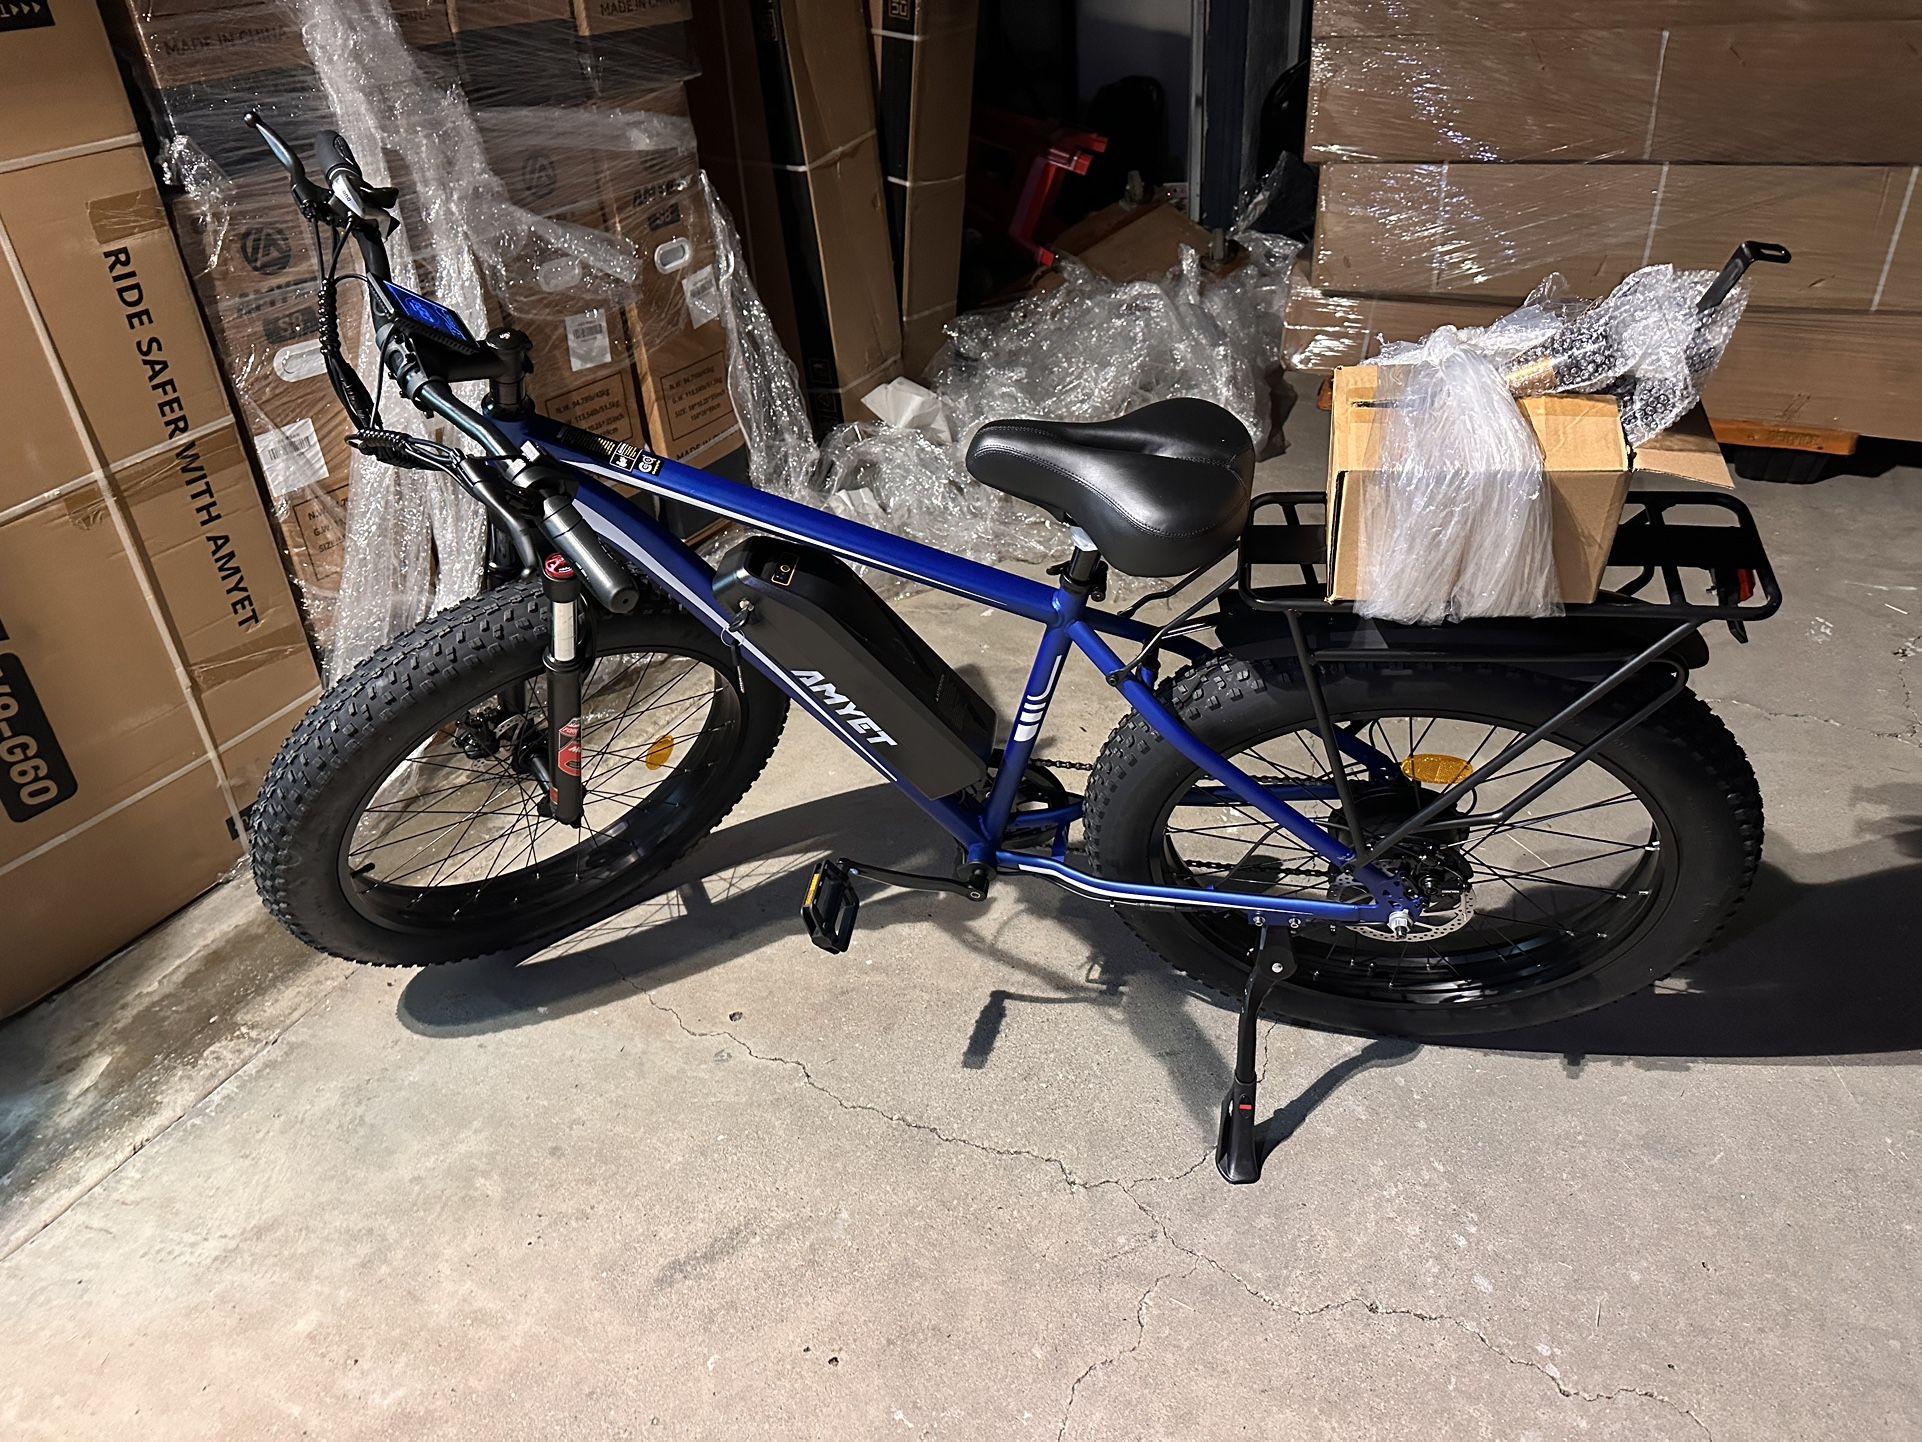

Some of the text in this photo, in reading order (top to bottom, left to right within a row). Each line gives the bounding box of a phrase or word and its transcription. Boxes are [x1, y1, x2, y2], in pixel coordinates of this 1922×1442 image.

[600, 1, 634, 16] MADE
[103, 246, 260, 627] RIDE SAFER WITH AMYET
[790, 670, 898, 746] AMYET
